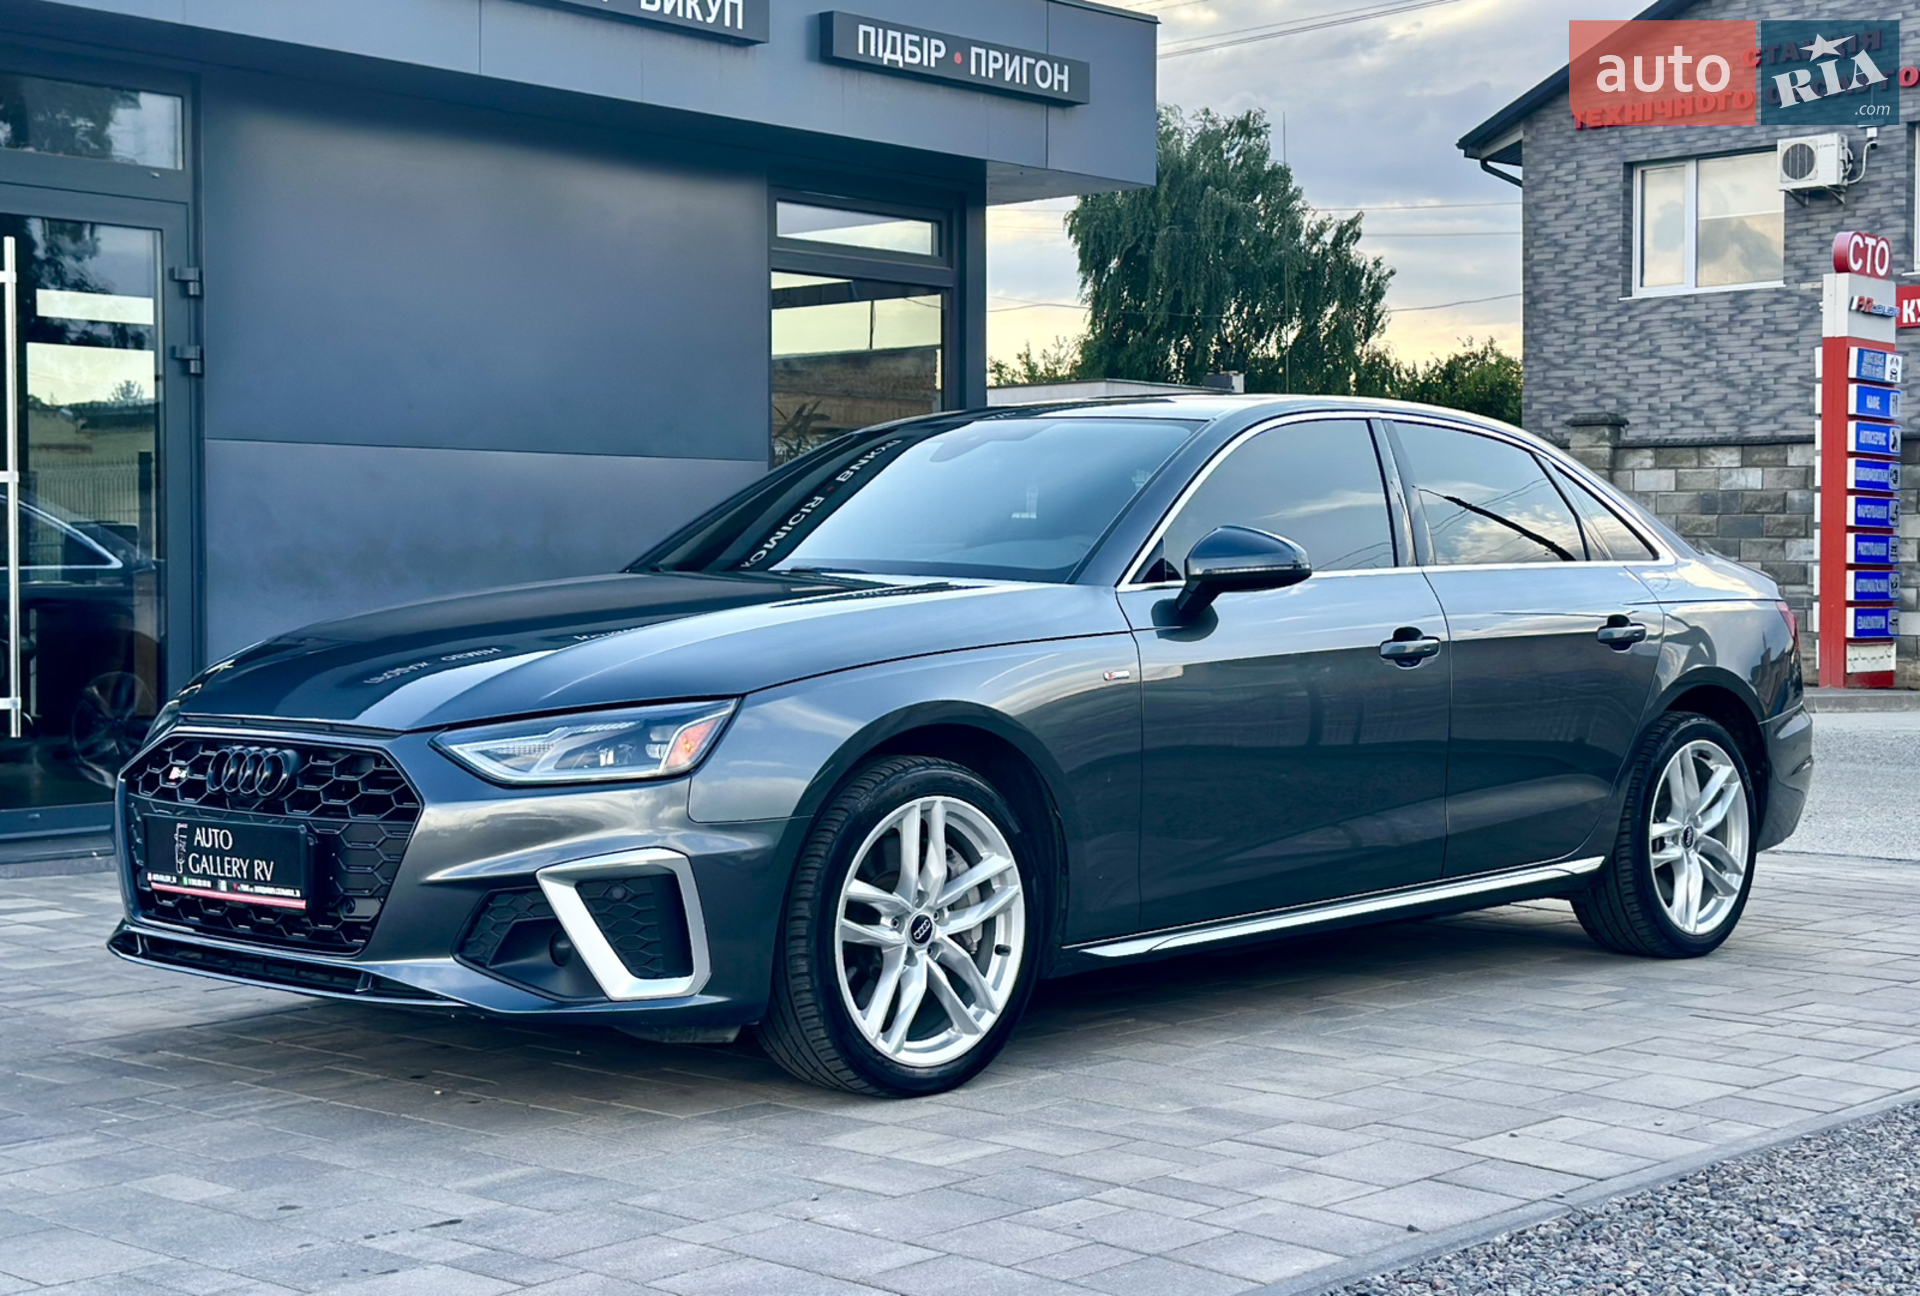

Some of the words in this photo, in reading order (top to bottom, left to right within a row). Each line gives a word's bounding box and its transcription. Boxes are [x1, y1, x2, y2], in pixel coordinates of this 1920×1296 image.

[857, 24, 947, 68] ПІДБІР
[970, 46, 1069, 92] ПРИГОН
[1572, 89, 1756, 131] ТЕХНІЧНОГО
[1849, 234, 1890, 276] СТО
[193, 826, 233, 851] AUTO
[187, 852, 250, 879] GALLERY
[253, 859, 275, 882] RV
